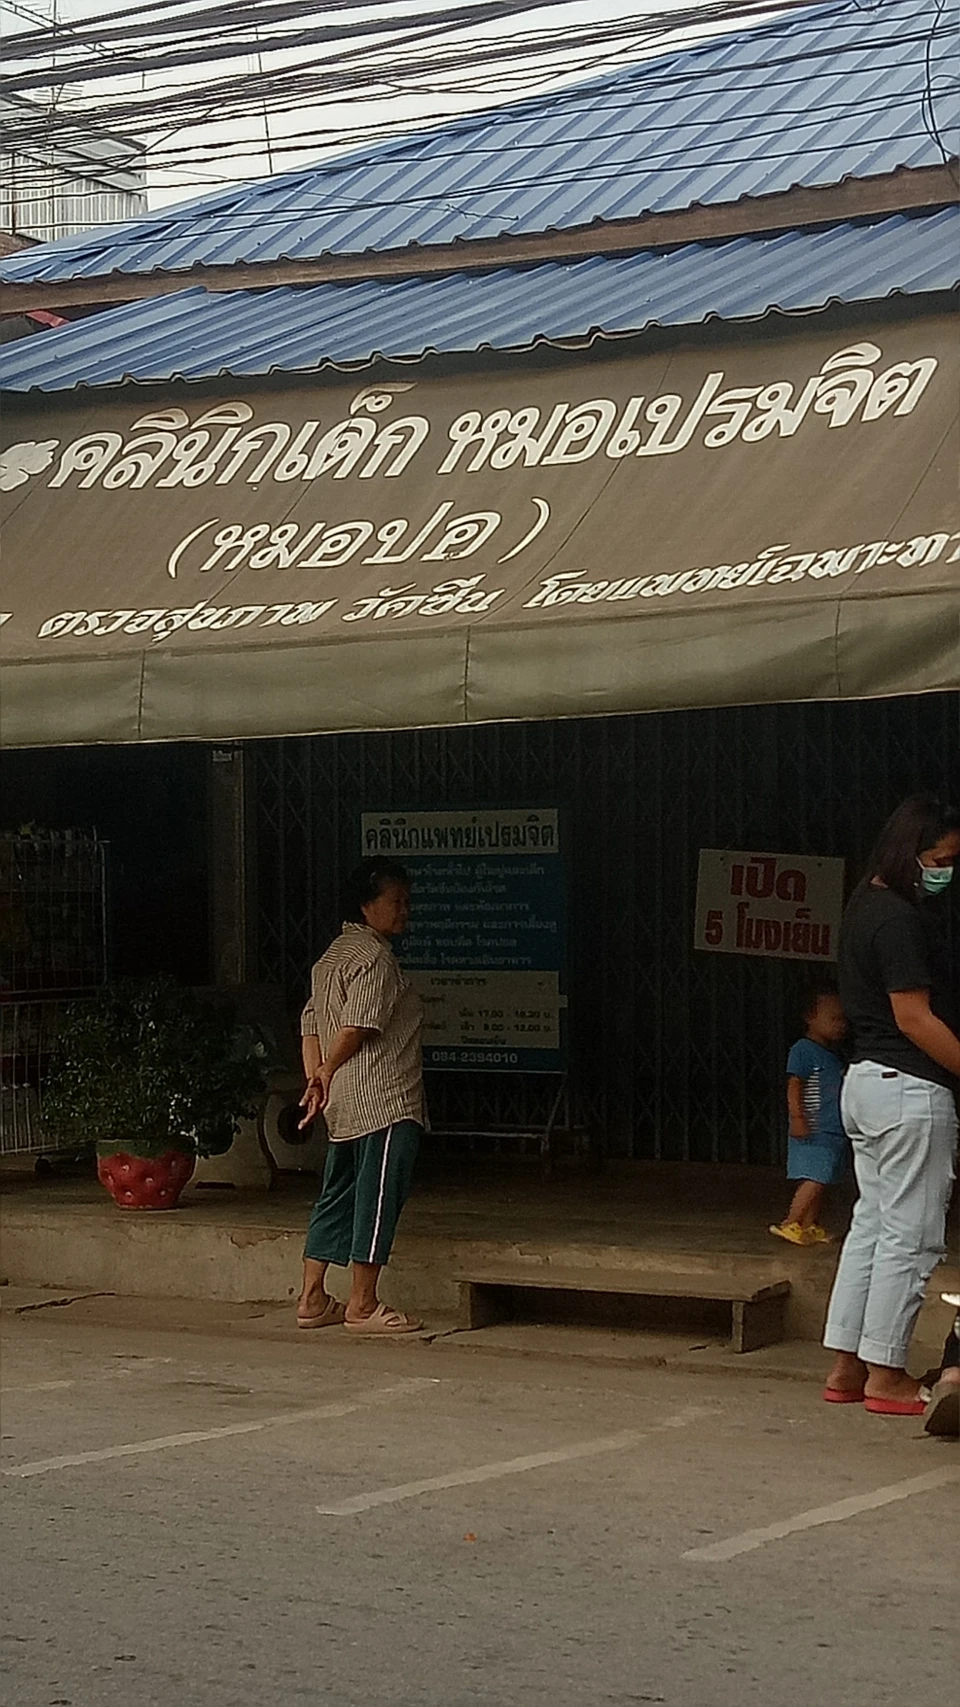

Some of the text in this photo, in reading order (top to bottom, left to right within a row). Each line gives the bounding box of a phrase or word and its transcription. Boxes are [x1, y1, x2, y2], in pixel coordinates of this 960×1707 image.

[47, 341, 939, 490] คลินิกเด็ก หมอเปรมจิต
[37, 598, 339, 643] ตรวจสุขภาพ
[341, 573, 506, 624] วัคซีน
[365, 815, 555, 850] คลินิกแพทย์เปรมจิต
[730, 857, 807, 903] เปิด
[705, 901, 831, 956] 5 โมงเย็น
